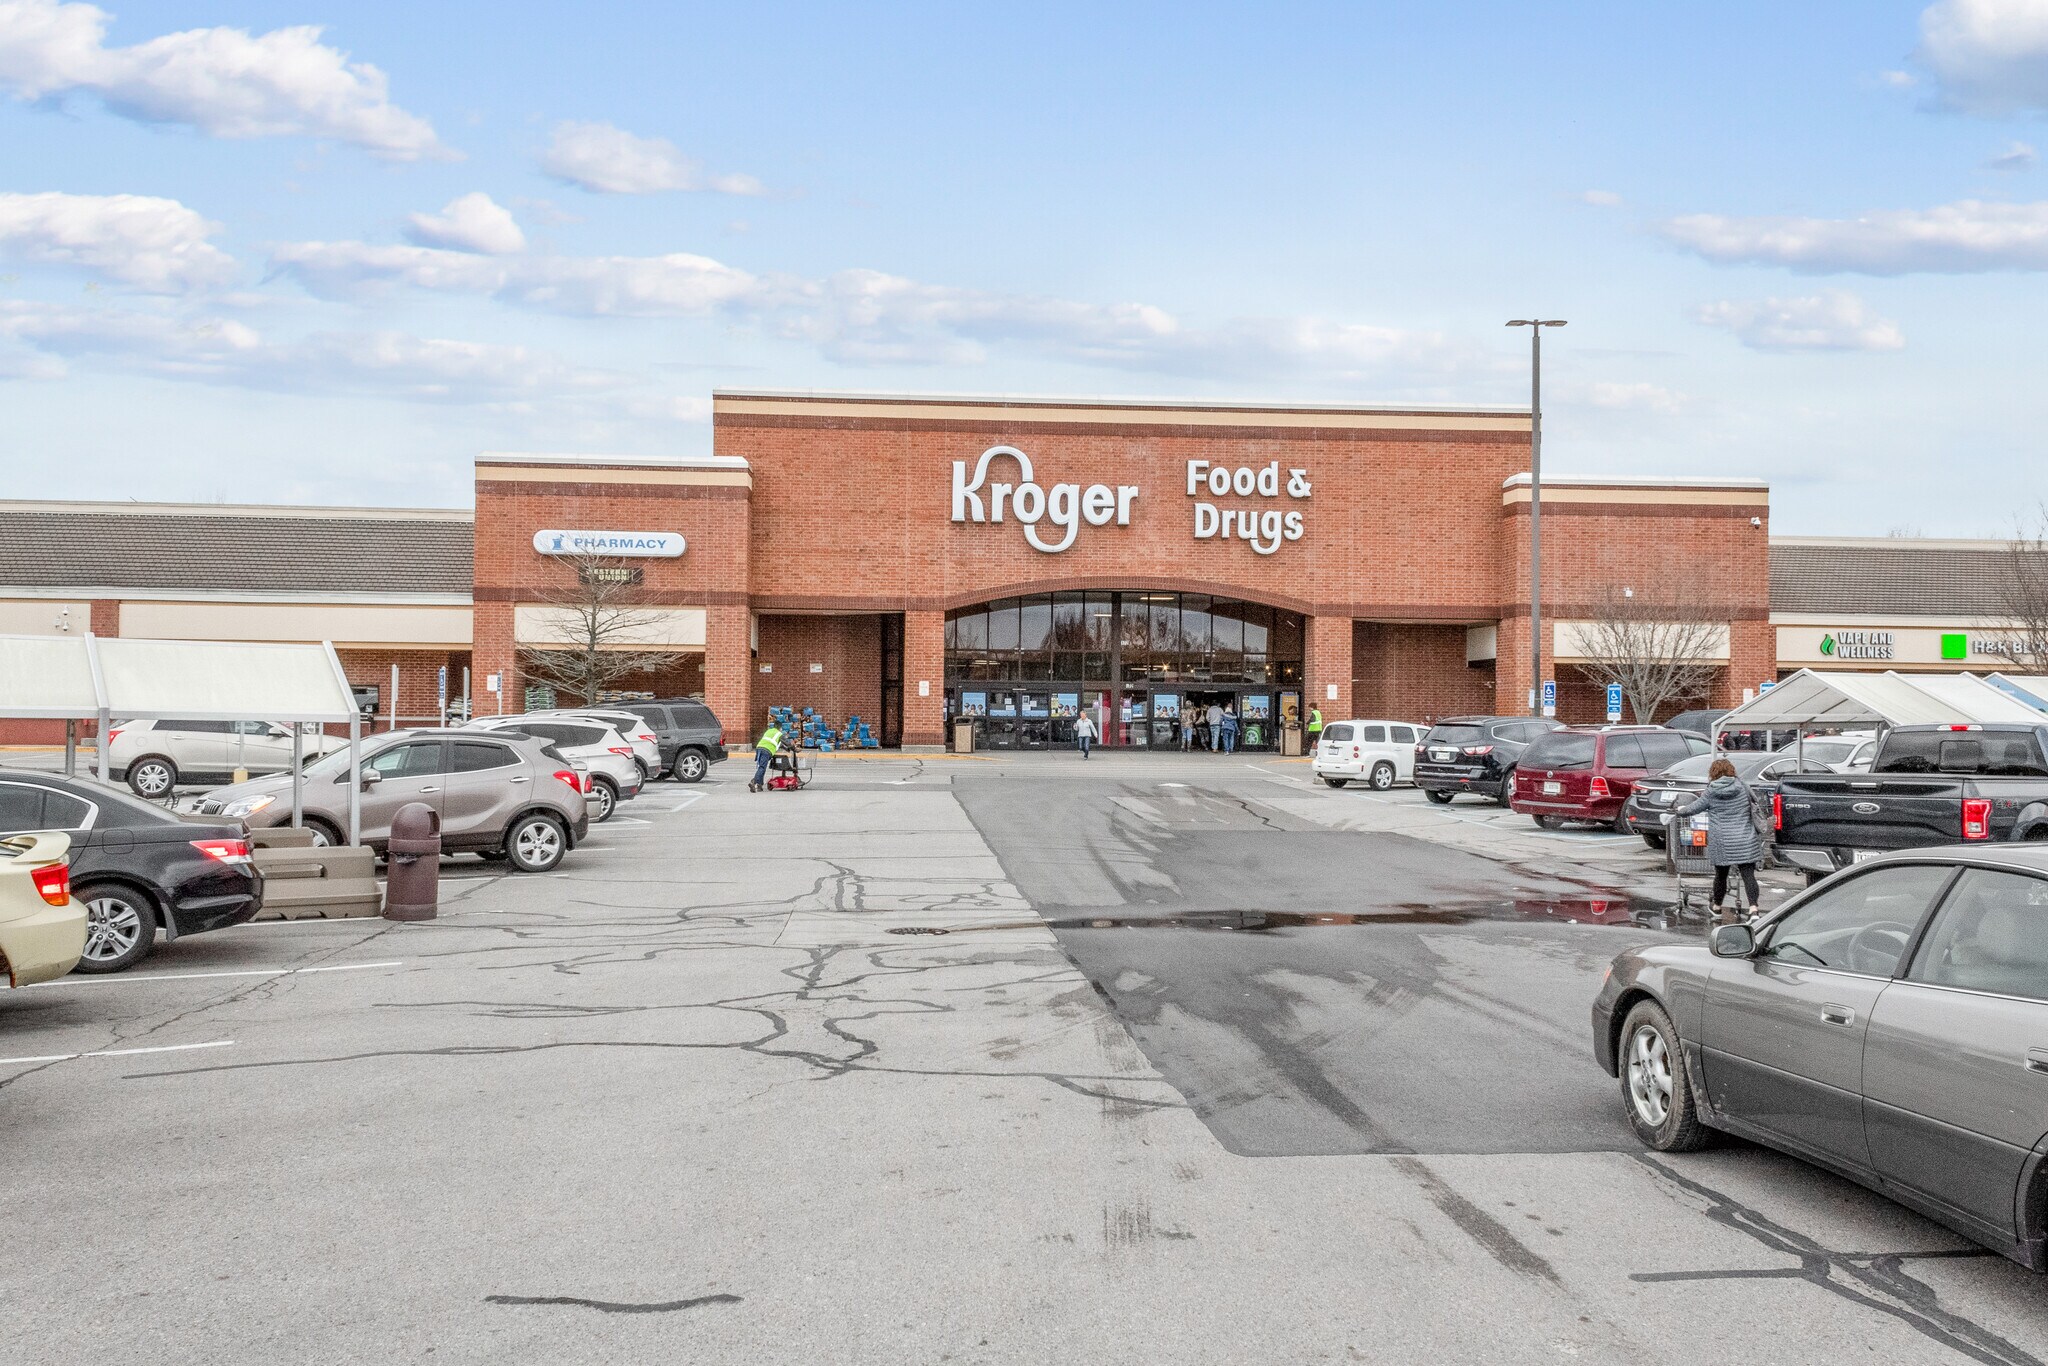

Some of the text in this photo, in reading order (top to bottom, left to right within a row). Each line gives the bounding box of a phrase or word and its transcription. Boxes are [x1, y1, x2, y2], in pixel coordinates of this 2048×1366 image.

[1187, 460, 1312, 497] Food &
[952, 446, 1139, 552] Kroger
[1194, 502, 1304, 554] Drugs
[574, 538, 667, 549] PHARMACY
[1838, 632, 1894, 645] VAPE AND
[1838, 646, 1894, 659] WELLNESS
